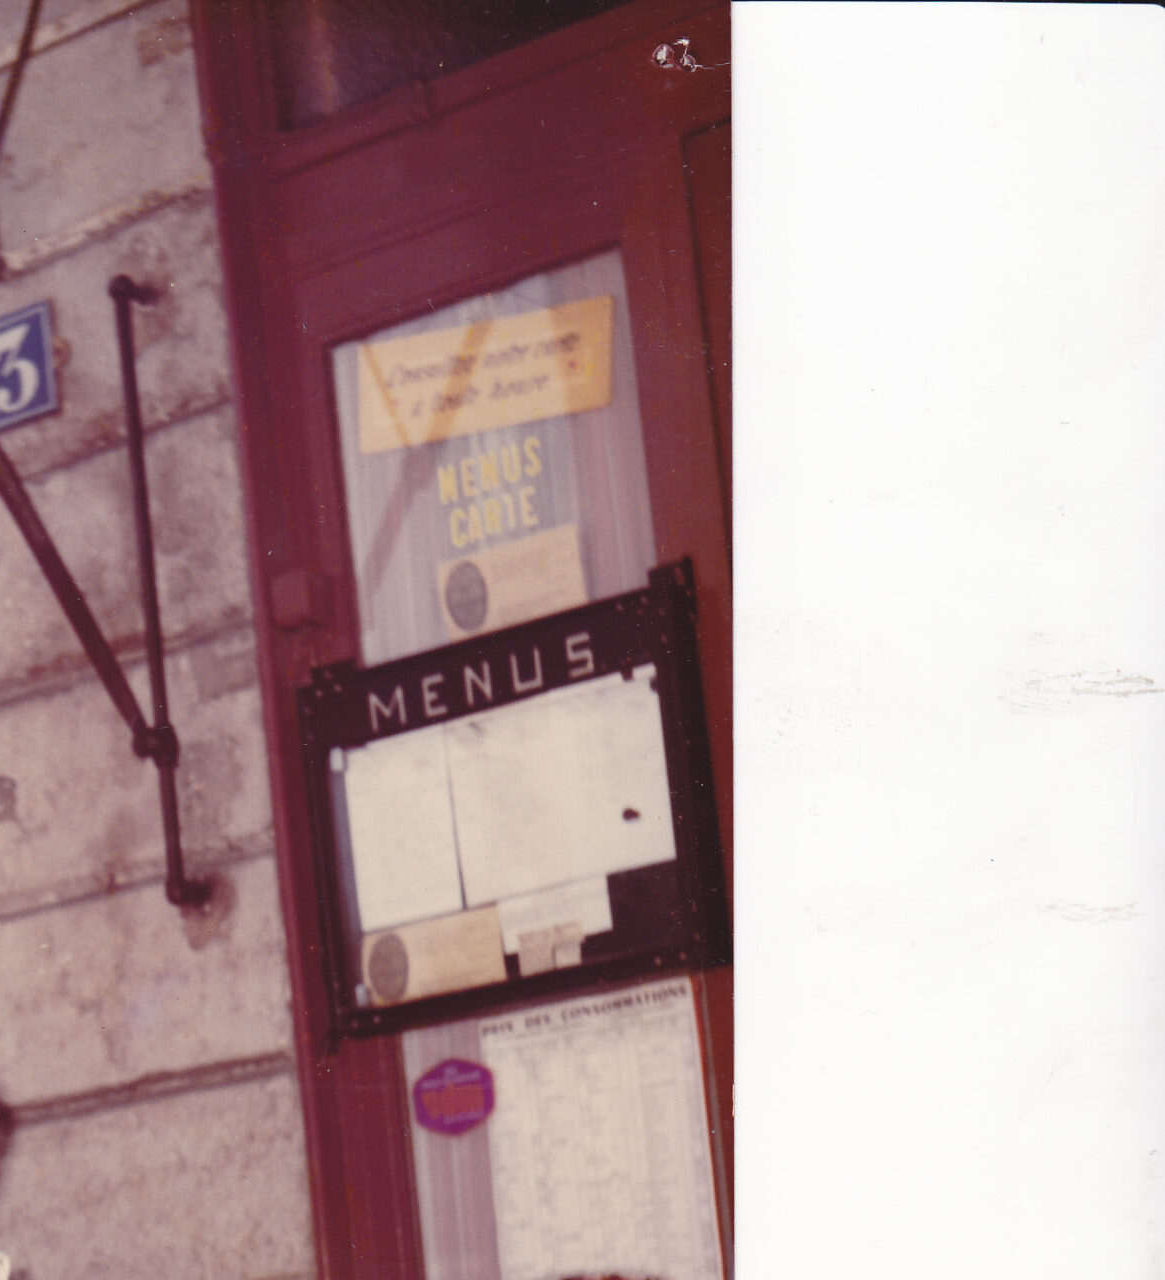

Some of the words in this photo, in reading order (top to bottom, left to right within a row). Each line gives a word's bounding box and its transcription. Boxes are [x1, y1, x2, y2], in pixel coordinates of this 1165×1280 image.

[437, 435, 543, 506] MENUS
[450, 485, 540, 549] CARTE
[368, 631, 595, 732] MENUS
[560, 984, 688, 1023] CONSOMMATIONS
